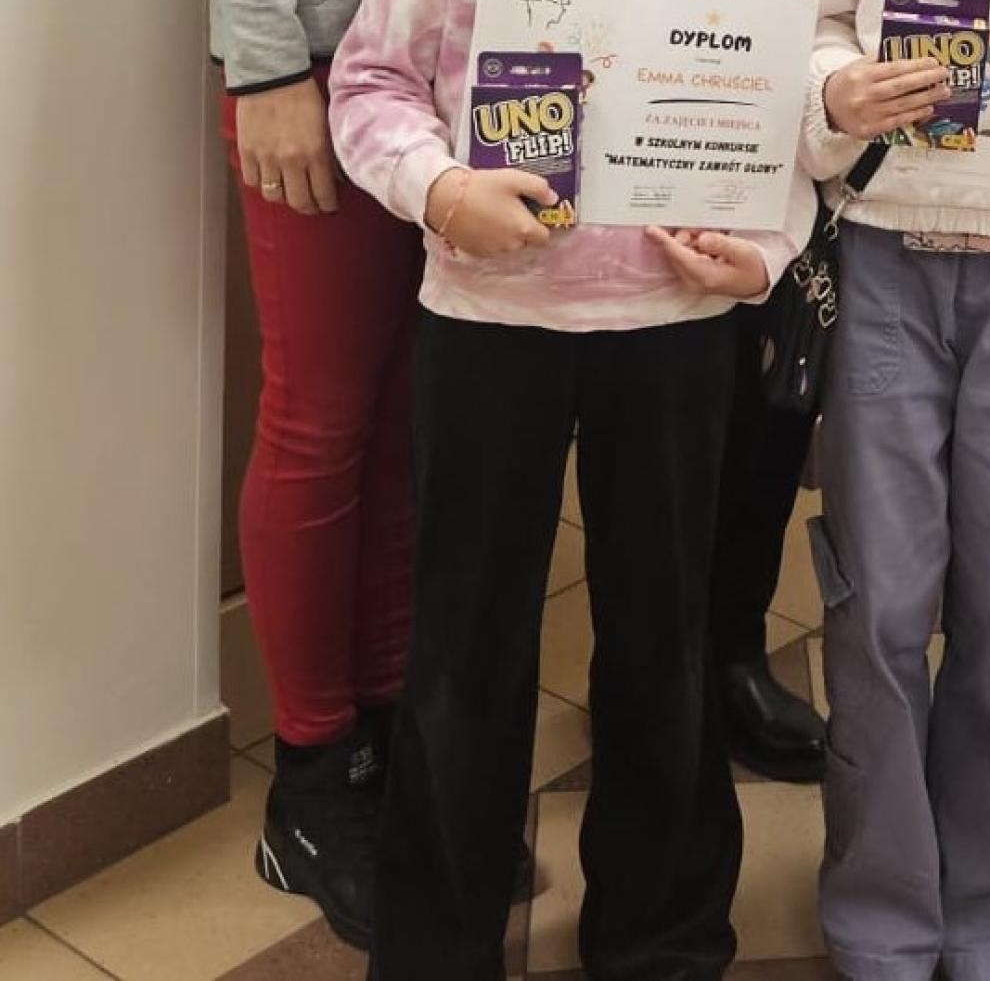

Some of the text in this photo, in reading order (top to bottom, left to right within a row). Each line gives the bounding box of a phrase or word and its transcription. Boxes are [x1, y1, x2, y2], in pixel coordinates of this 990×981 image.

[669, 28, 752, 52] DYPLOM
[637, 68, 684, 84] EMMA
[475, 92, 573, 144] UNO
[508, 132, 573, 164] FLIP!
[635, 136, 760, 154] W SZKOLNYM KONKURSIE
[699, 159, 742, 173] ZAWRÓT
